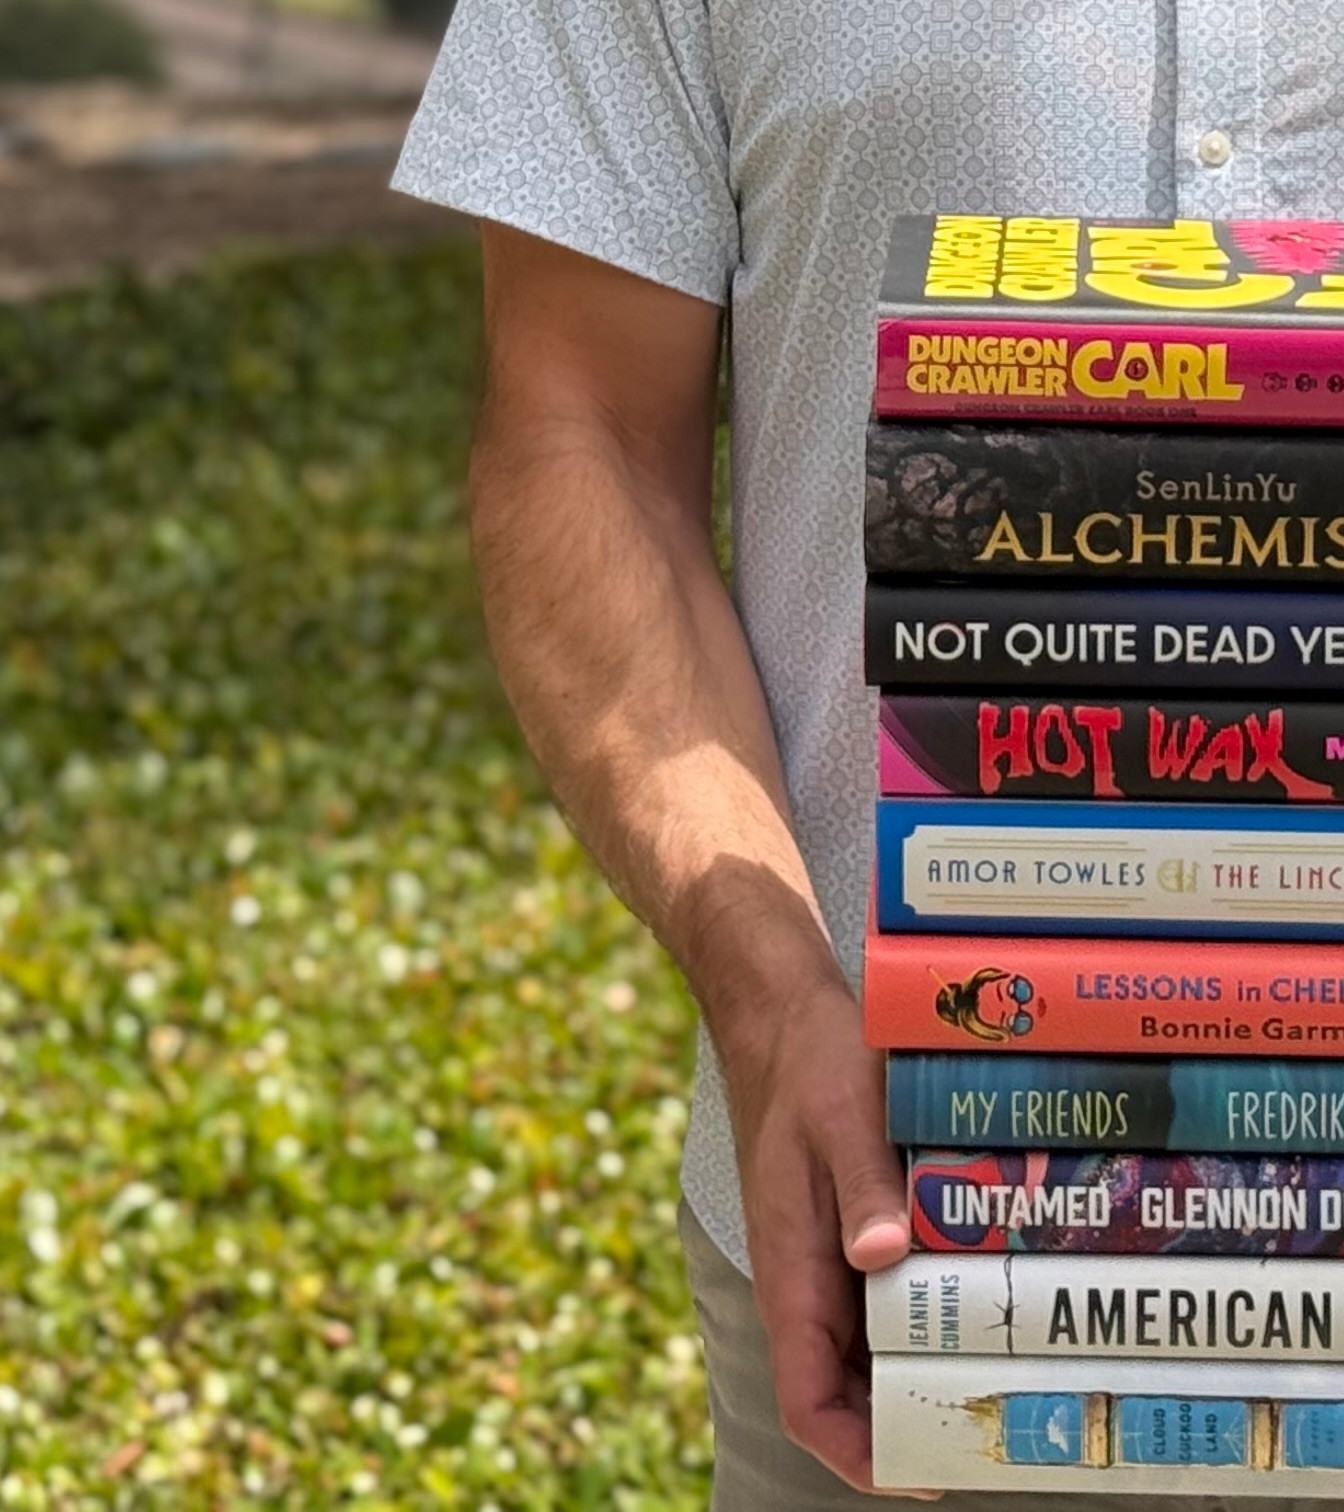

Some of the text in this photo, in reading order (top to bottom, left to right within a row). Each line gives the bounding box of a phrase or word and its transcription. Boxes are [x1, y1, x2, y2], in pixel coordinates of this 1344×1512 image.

[1084, 219, 1296, 309] CARL
[907, 335, 1068, 367] DUNGEON
[1071, 340, 1246, 401] CARL
[906, 364, 1068, 397] CRAWLER
[1136, 471, 1297, 503] SenLinYu
[895, 622, 990, 662] NOT
[1005, 622, 1137, 666] QUITE
[1154, 624, 1276, 665] DEAD
[977, 701, 1336, 801] HOT WAX
[927, 858, 1146, 887] AMOR TOWLES
[1213, 863, 1260, 889] THE
[1075, 973, 1223, 1003] LESSONS
[1237, 980, 1261, 1003] in
[1141, 1015, 1251, 1040] Bonnie
[950, 1089, 1131, 1138] MY FRIENDS
[941, 1183, 1110, 1231] UNTAMED
[1141, 1187, 1307, 1231] GLENNON
[909, 1279, 929, 1347] JEANINE
[940, 1274, 960, 1350] CUMMINS
[1046, 1287, 1332, 1350] AMERICAN
[1153, 1408, 1166, 1456] CLOUD
[1179, 1403, 1192, 1461] CUCKOO
[1205, 1413, 1218, 1453] LAND
